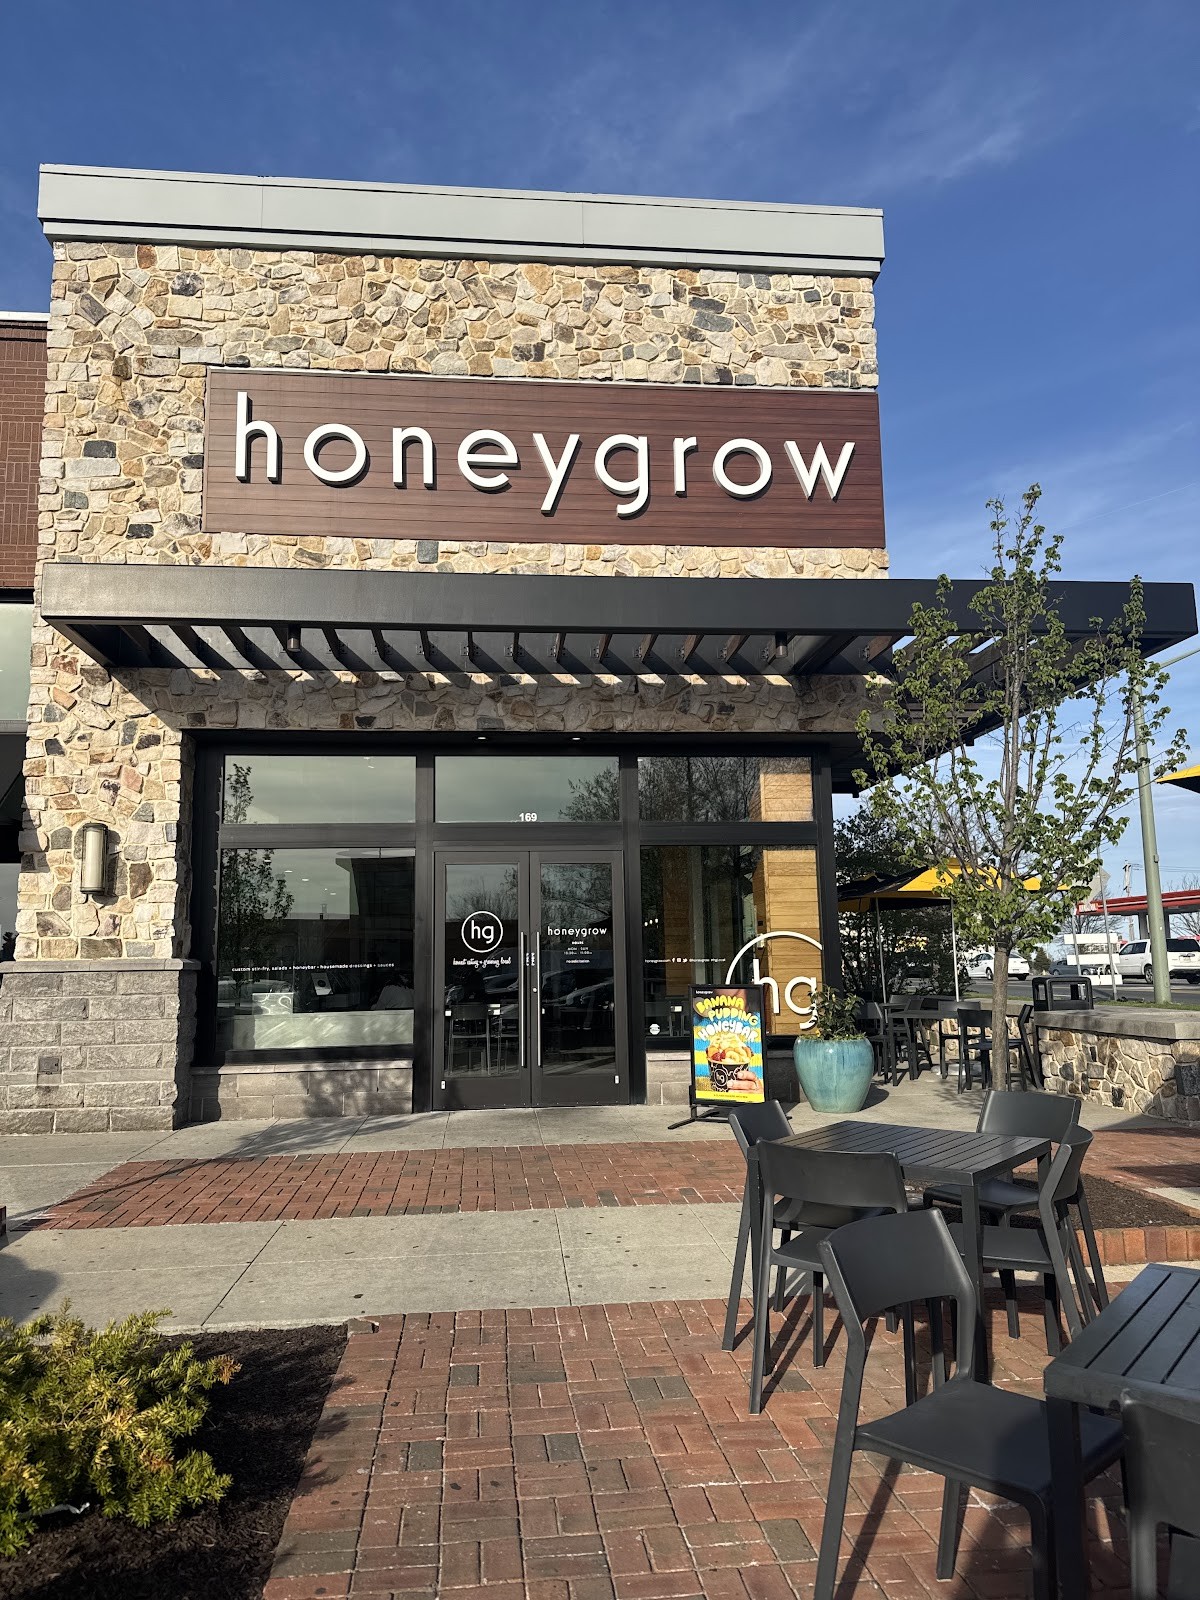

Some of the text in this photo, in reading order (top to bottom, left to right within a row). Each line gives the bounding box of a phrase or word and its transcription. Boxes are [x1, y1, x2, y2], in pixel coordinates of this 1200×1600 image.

[234, 391, 855, 518] honeygrow
[518, 812, 538, 822] 169
[470, 919, 495, 945] hg
[547, 925, 608, 938] honeygrow
[695, 994, 745, 1014] BANANA
[707, 1007, 759, 1026] PUDDING
